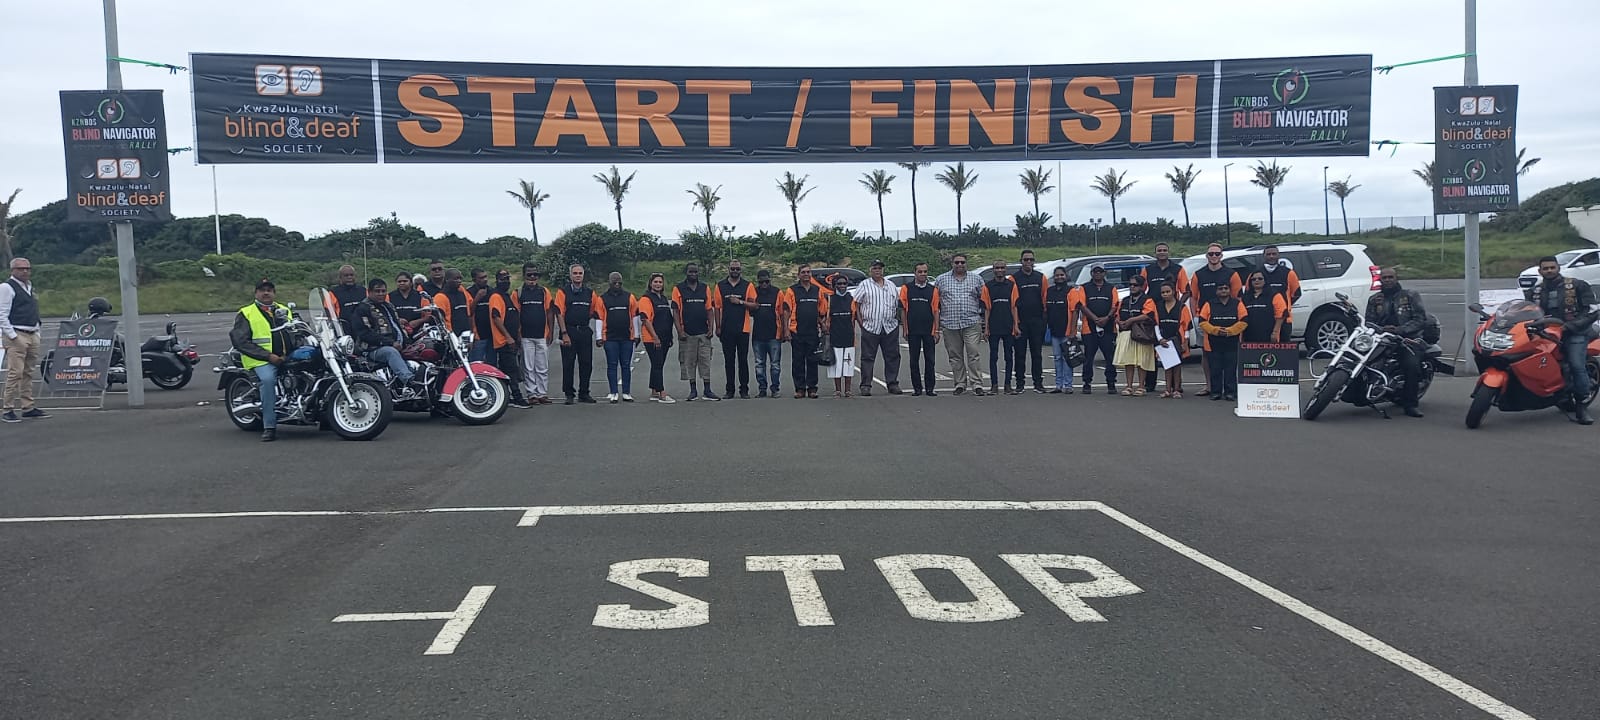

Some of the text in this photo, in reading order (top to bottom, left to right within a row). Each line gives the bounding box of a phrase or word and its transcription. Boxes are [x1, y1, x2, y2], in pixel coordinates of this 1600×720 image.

[1233, 96, 1269, 107] KZNBDS
[243, 104, 339, 114] KwaZulu-Natal
[396, 73, 1199, 148] START / FINISH
[1233, 109, 1349, 128] BLIND NAVIGATOR
[224, 115, 361, 138] blind&deaf
[72, 127, 157, 140] BLIND NAVIGATOR
[1310, 129, 1348, 141] RALLY
[1442, 126, 1513, 141] blind&deaf
[129, 141, 157, 149] RALLY
[263, 144, 323, 153] SOCIETY
[89, 183, 151, 191] KwaZulu-Natal
[1442, 184, 1510, 197] BLIND NAVIGATOR
[77, 191, 165, 207] blind&deaf
[1261, 369, 1294, 377] NAVIGATOR
[592, 553, 1146, 631] STOP
